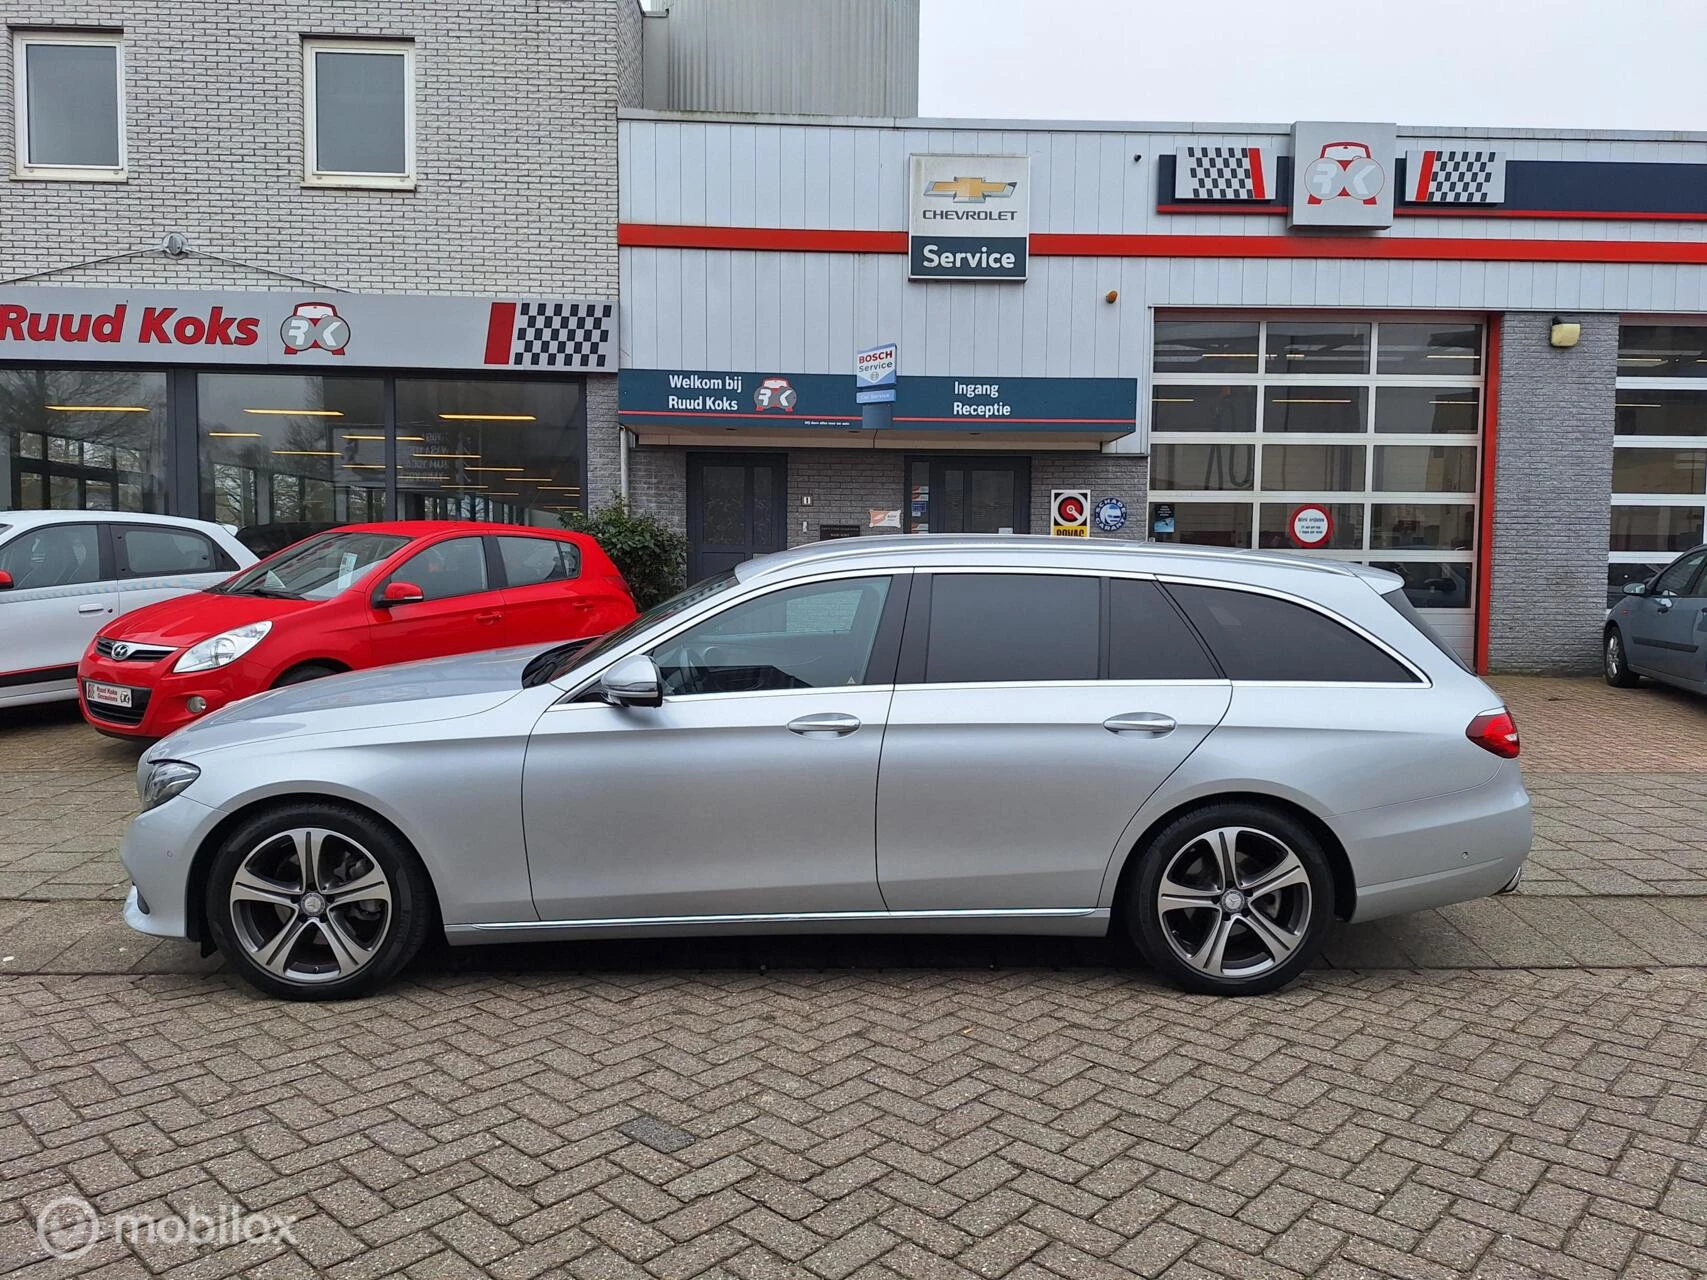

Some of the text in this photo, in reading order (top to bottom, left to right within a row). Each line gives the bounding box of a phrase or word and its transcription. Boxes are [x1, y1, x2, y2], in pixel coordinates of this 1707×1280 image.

[922, 209, 1018, 221] CHEVROLET
[922, 244, 1016, 268] Service
[0, 303, 261, 346] Ruud Koks
[858, 350, 893, 365] BOSCH
[858, 361, 893, 373] Service
[668, 374, 742, 393] Welkom bij
[954, 381, 999, 398] Ingang
[668, 395, 738, 411] Ruud Koks
[953, 401, 1011, 418] Receptie
